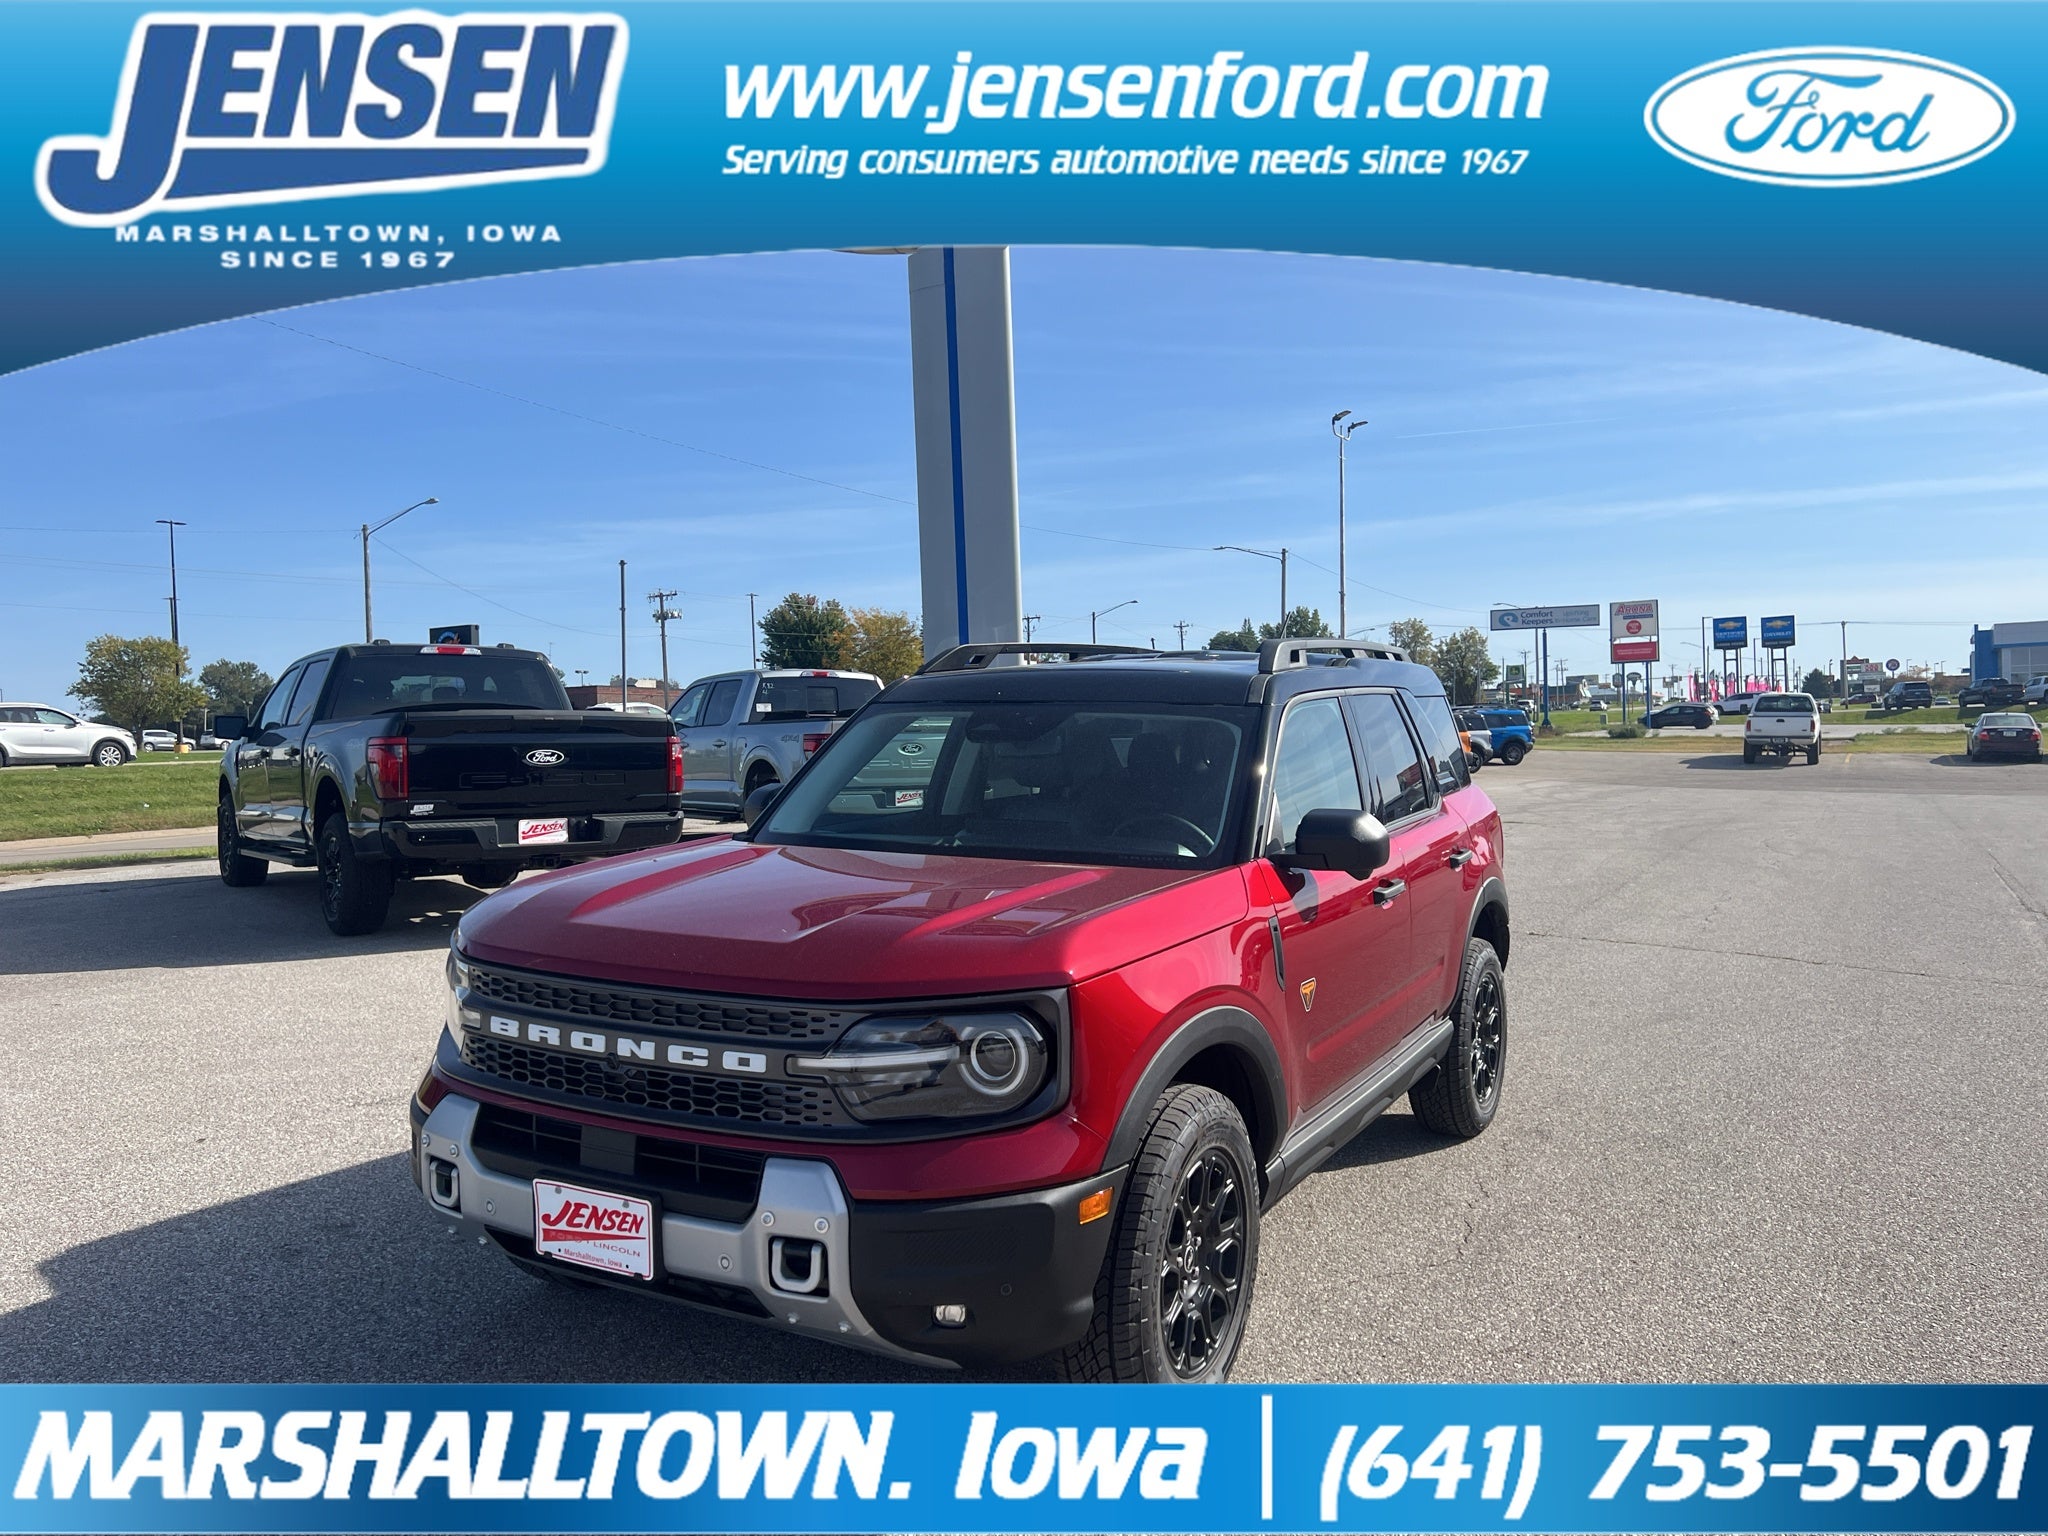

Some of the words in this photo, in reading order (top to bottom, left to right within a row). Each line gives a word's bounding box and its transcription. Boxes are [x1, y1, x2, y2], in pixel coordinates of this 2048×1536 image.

[1520, 610, 1553, 619] Comfort
[1521, 617, 1554, 626] Keepers
[521, 822, 565, 835] JENSEN
[489, 1015, 767, 1073] BRONCO
[541, 1200, 645, 1234] JENSEN
[548, 1230, 584, 1244] FORD
[592, 1240, 641, 1258] LINCOLN
[607, 1258, 623, 1269] Iowa
